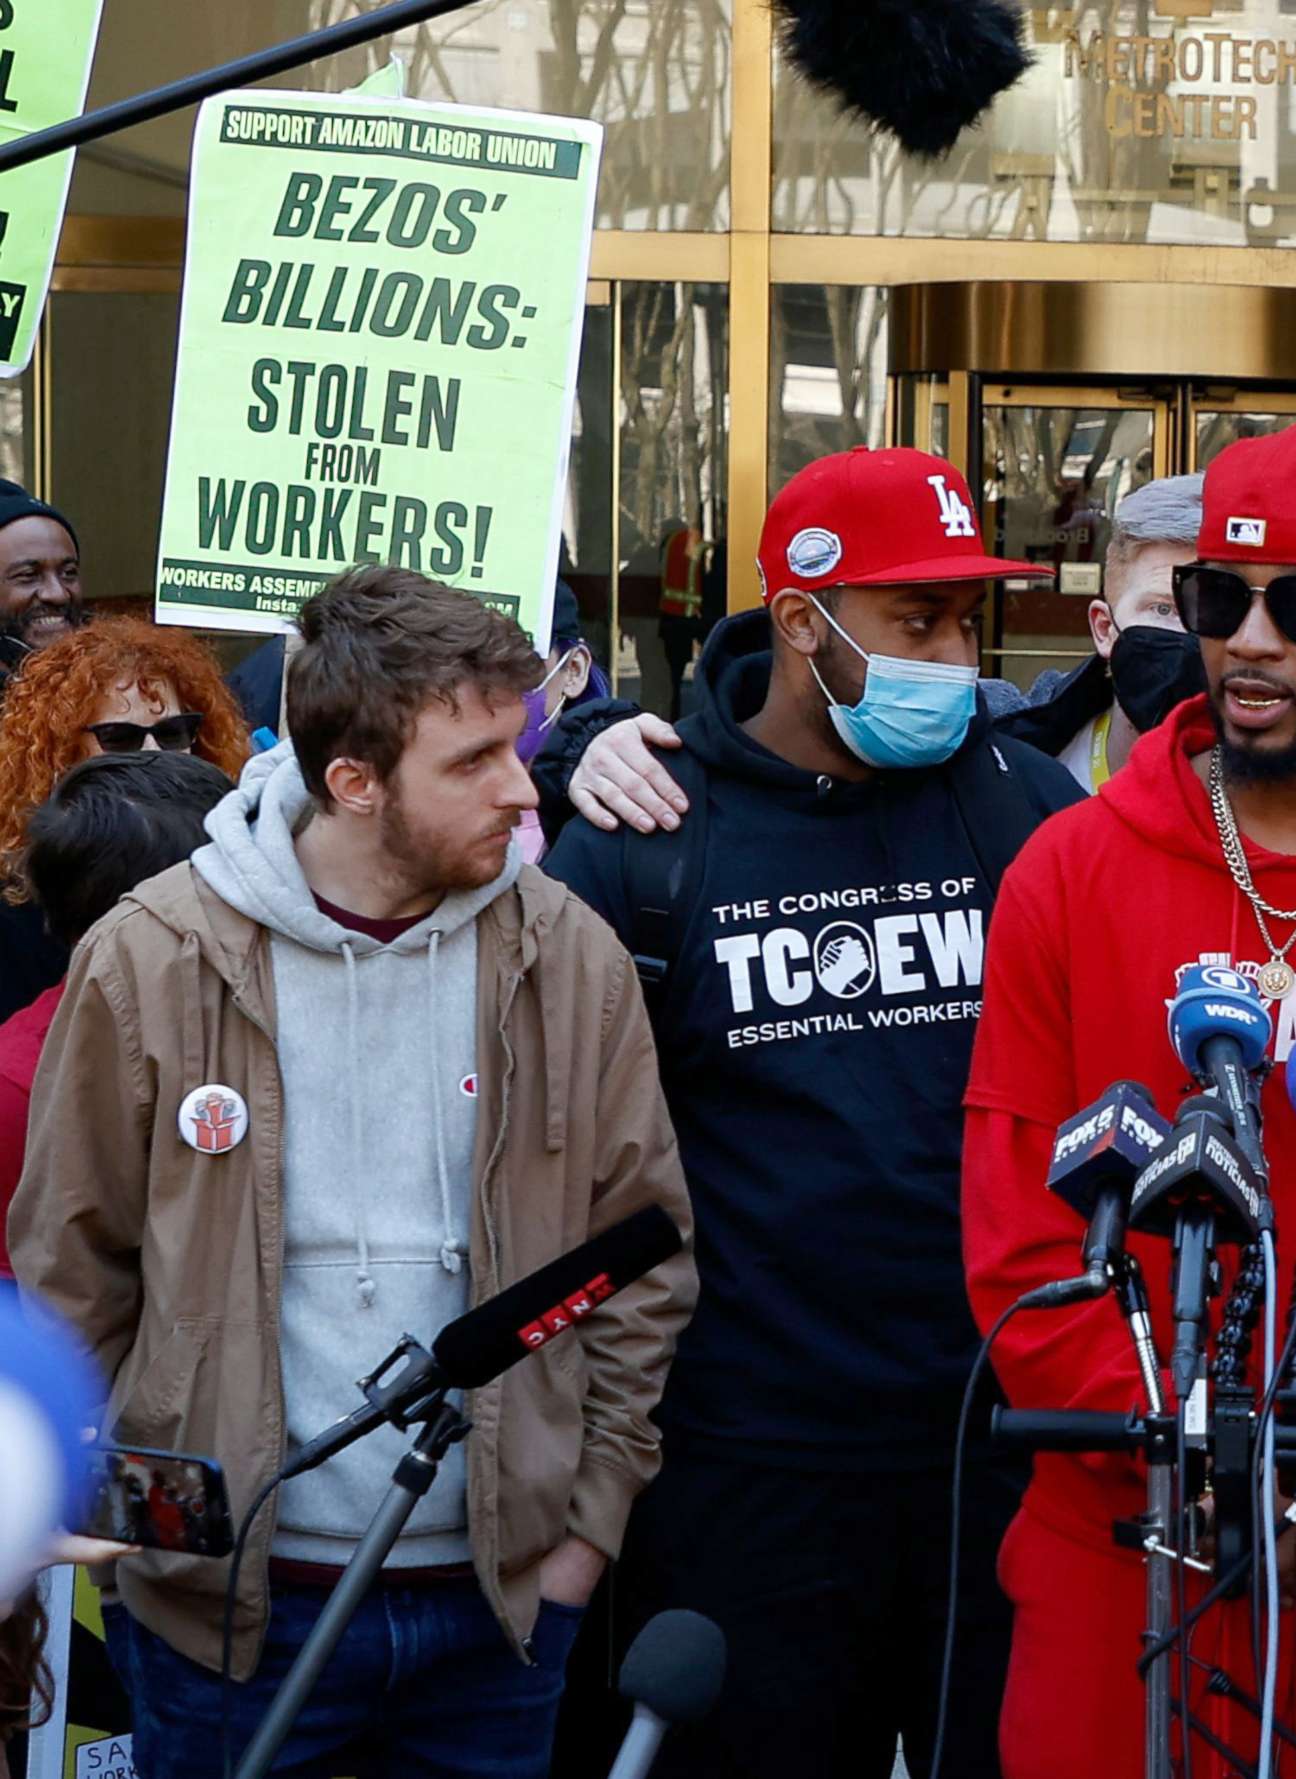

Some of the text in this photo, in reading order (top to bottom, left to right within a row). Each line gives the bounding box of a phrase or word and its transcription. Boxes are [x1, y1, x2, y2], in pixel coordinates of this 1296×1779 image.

[226, 109, 556, 169] SUPPORT AMAZON LABOR UNION
[273, 172, 508, 255] BEZOS'
[222, 259, 538, 350] BILLIONS:
[247, 358, 461, 453] STOLEN
[305, 441, 381, 487] FROM
[198, 475, 494, 579] WORKERS!
[927, 475, 976, 537] LA
[159, 565, 246, 593] WORKERS
[712, 899, 770, 923] THE
[940, 877, 976, 897] OF
[727, 1000, 983, 1048] ESSENTIAL WORKERS
[1204, 1003, 1251, 1024] WDR
